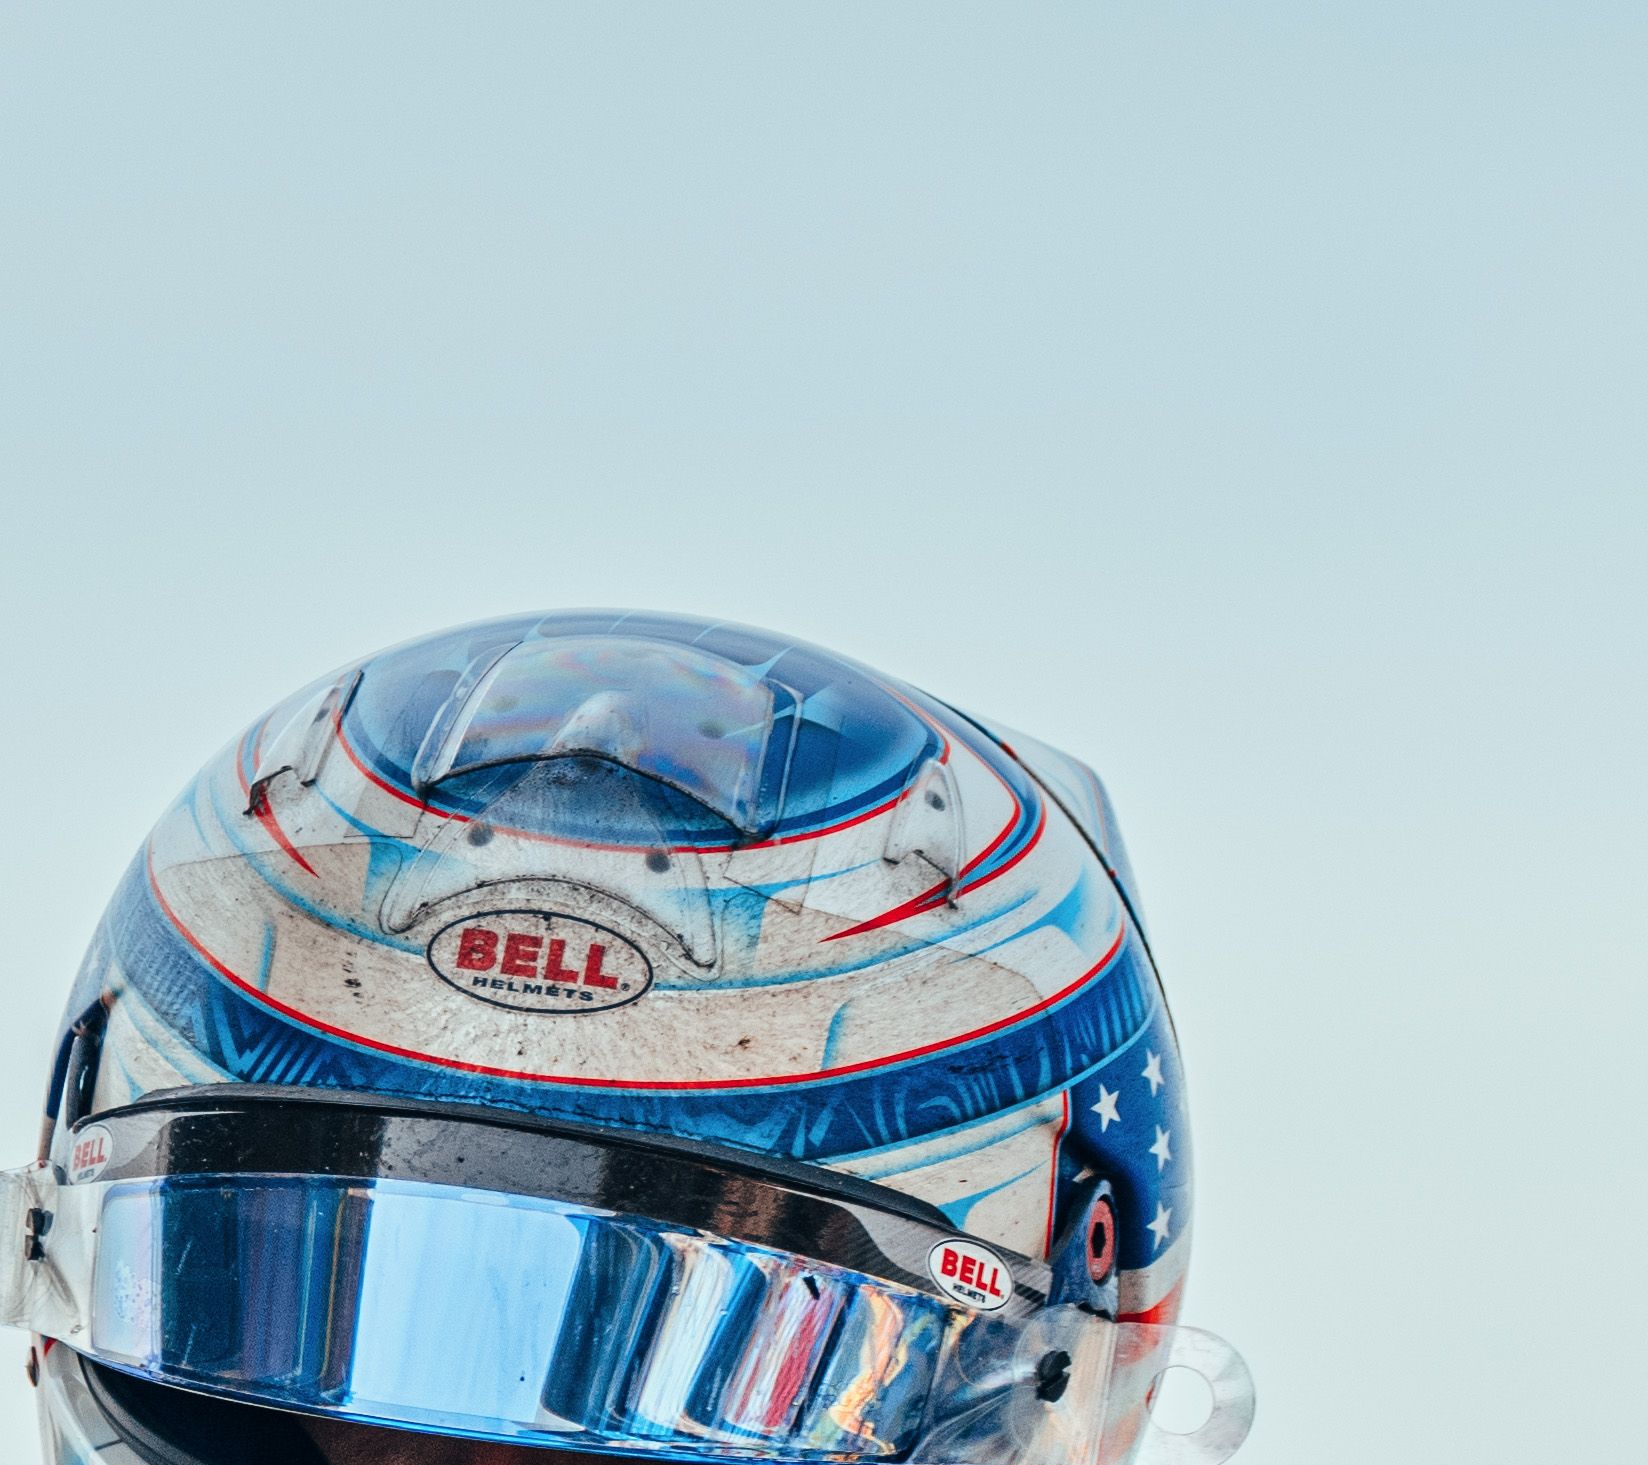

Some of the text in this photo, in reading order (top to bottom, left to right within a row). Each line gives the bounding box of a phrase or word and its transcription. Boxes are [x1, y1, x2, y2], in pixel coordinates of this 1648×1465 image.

[456, 928, 619, 990] BELL
[472, 976, 594, 1001] HELMETS
[73, 1137, 106, 1171] BELL
[941, 1247, 1001, 1297] BELL
